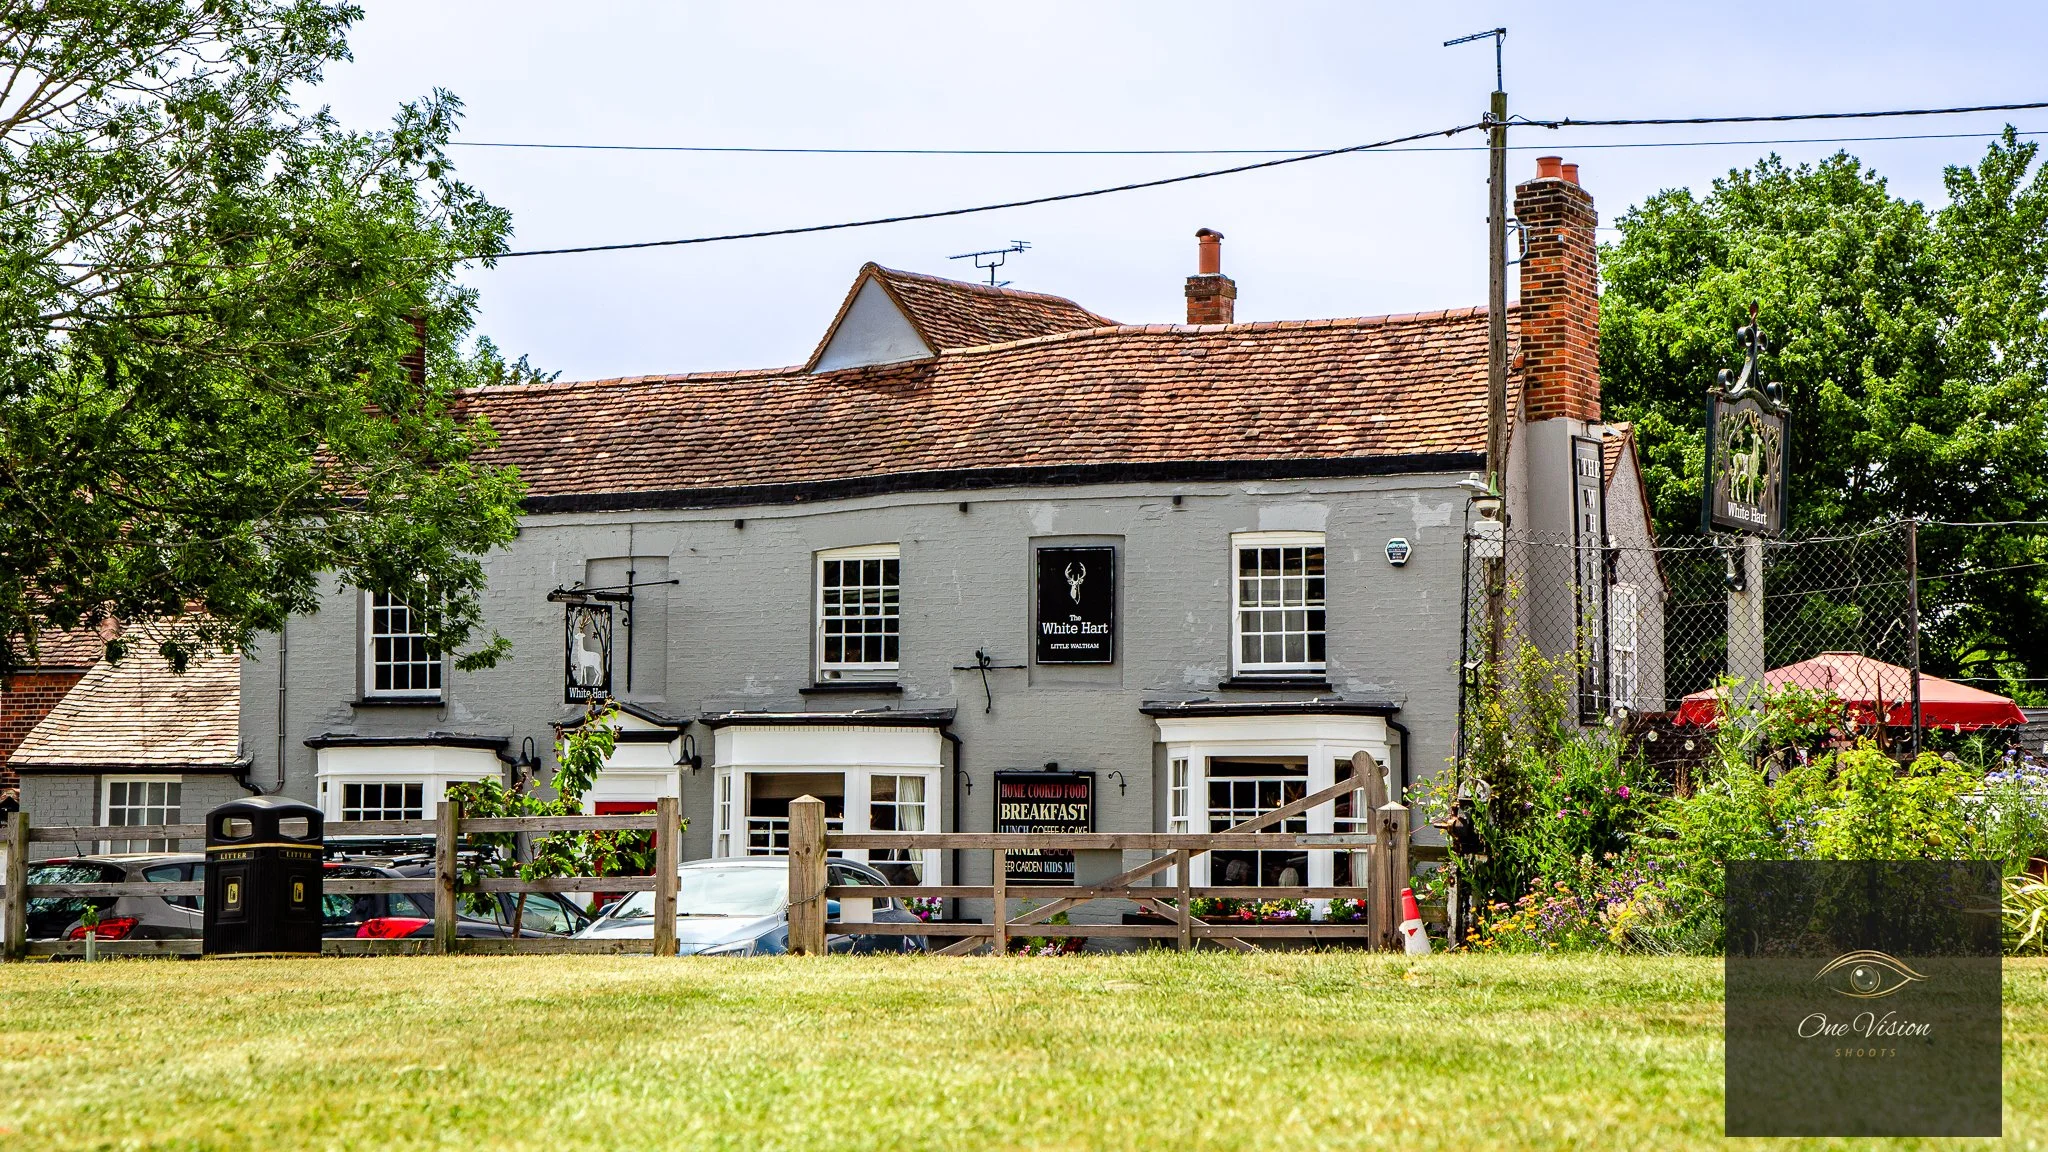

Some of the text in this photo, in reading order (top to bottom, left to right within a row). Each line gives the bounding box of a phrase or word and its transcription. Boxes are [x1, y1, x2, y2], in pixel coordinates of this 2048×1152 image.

[1581, 458, 1601, 479] THE
[1728, 501, 1767, 525] White Hart
[1069, 614, 1082, 622] The
[1042, 622, 1108, 634] White Hart
[569, 687, 608, 699] White Hart
[1001, 784, 1088, 799] HOME COOKED FOOD
[1001, 803, 1088, 821] BREAKFAST
[220, 852, 247, 860] LITTER
[286, 851, 312, 859] LITTER
[1016, 861, 1043, 873] GARDEN
[1044, 861, 1063, 873] KIDS
